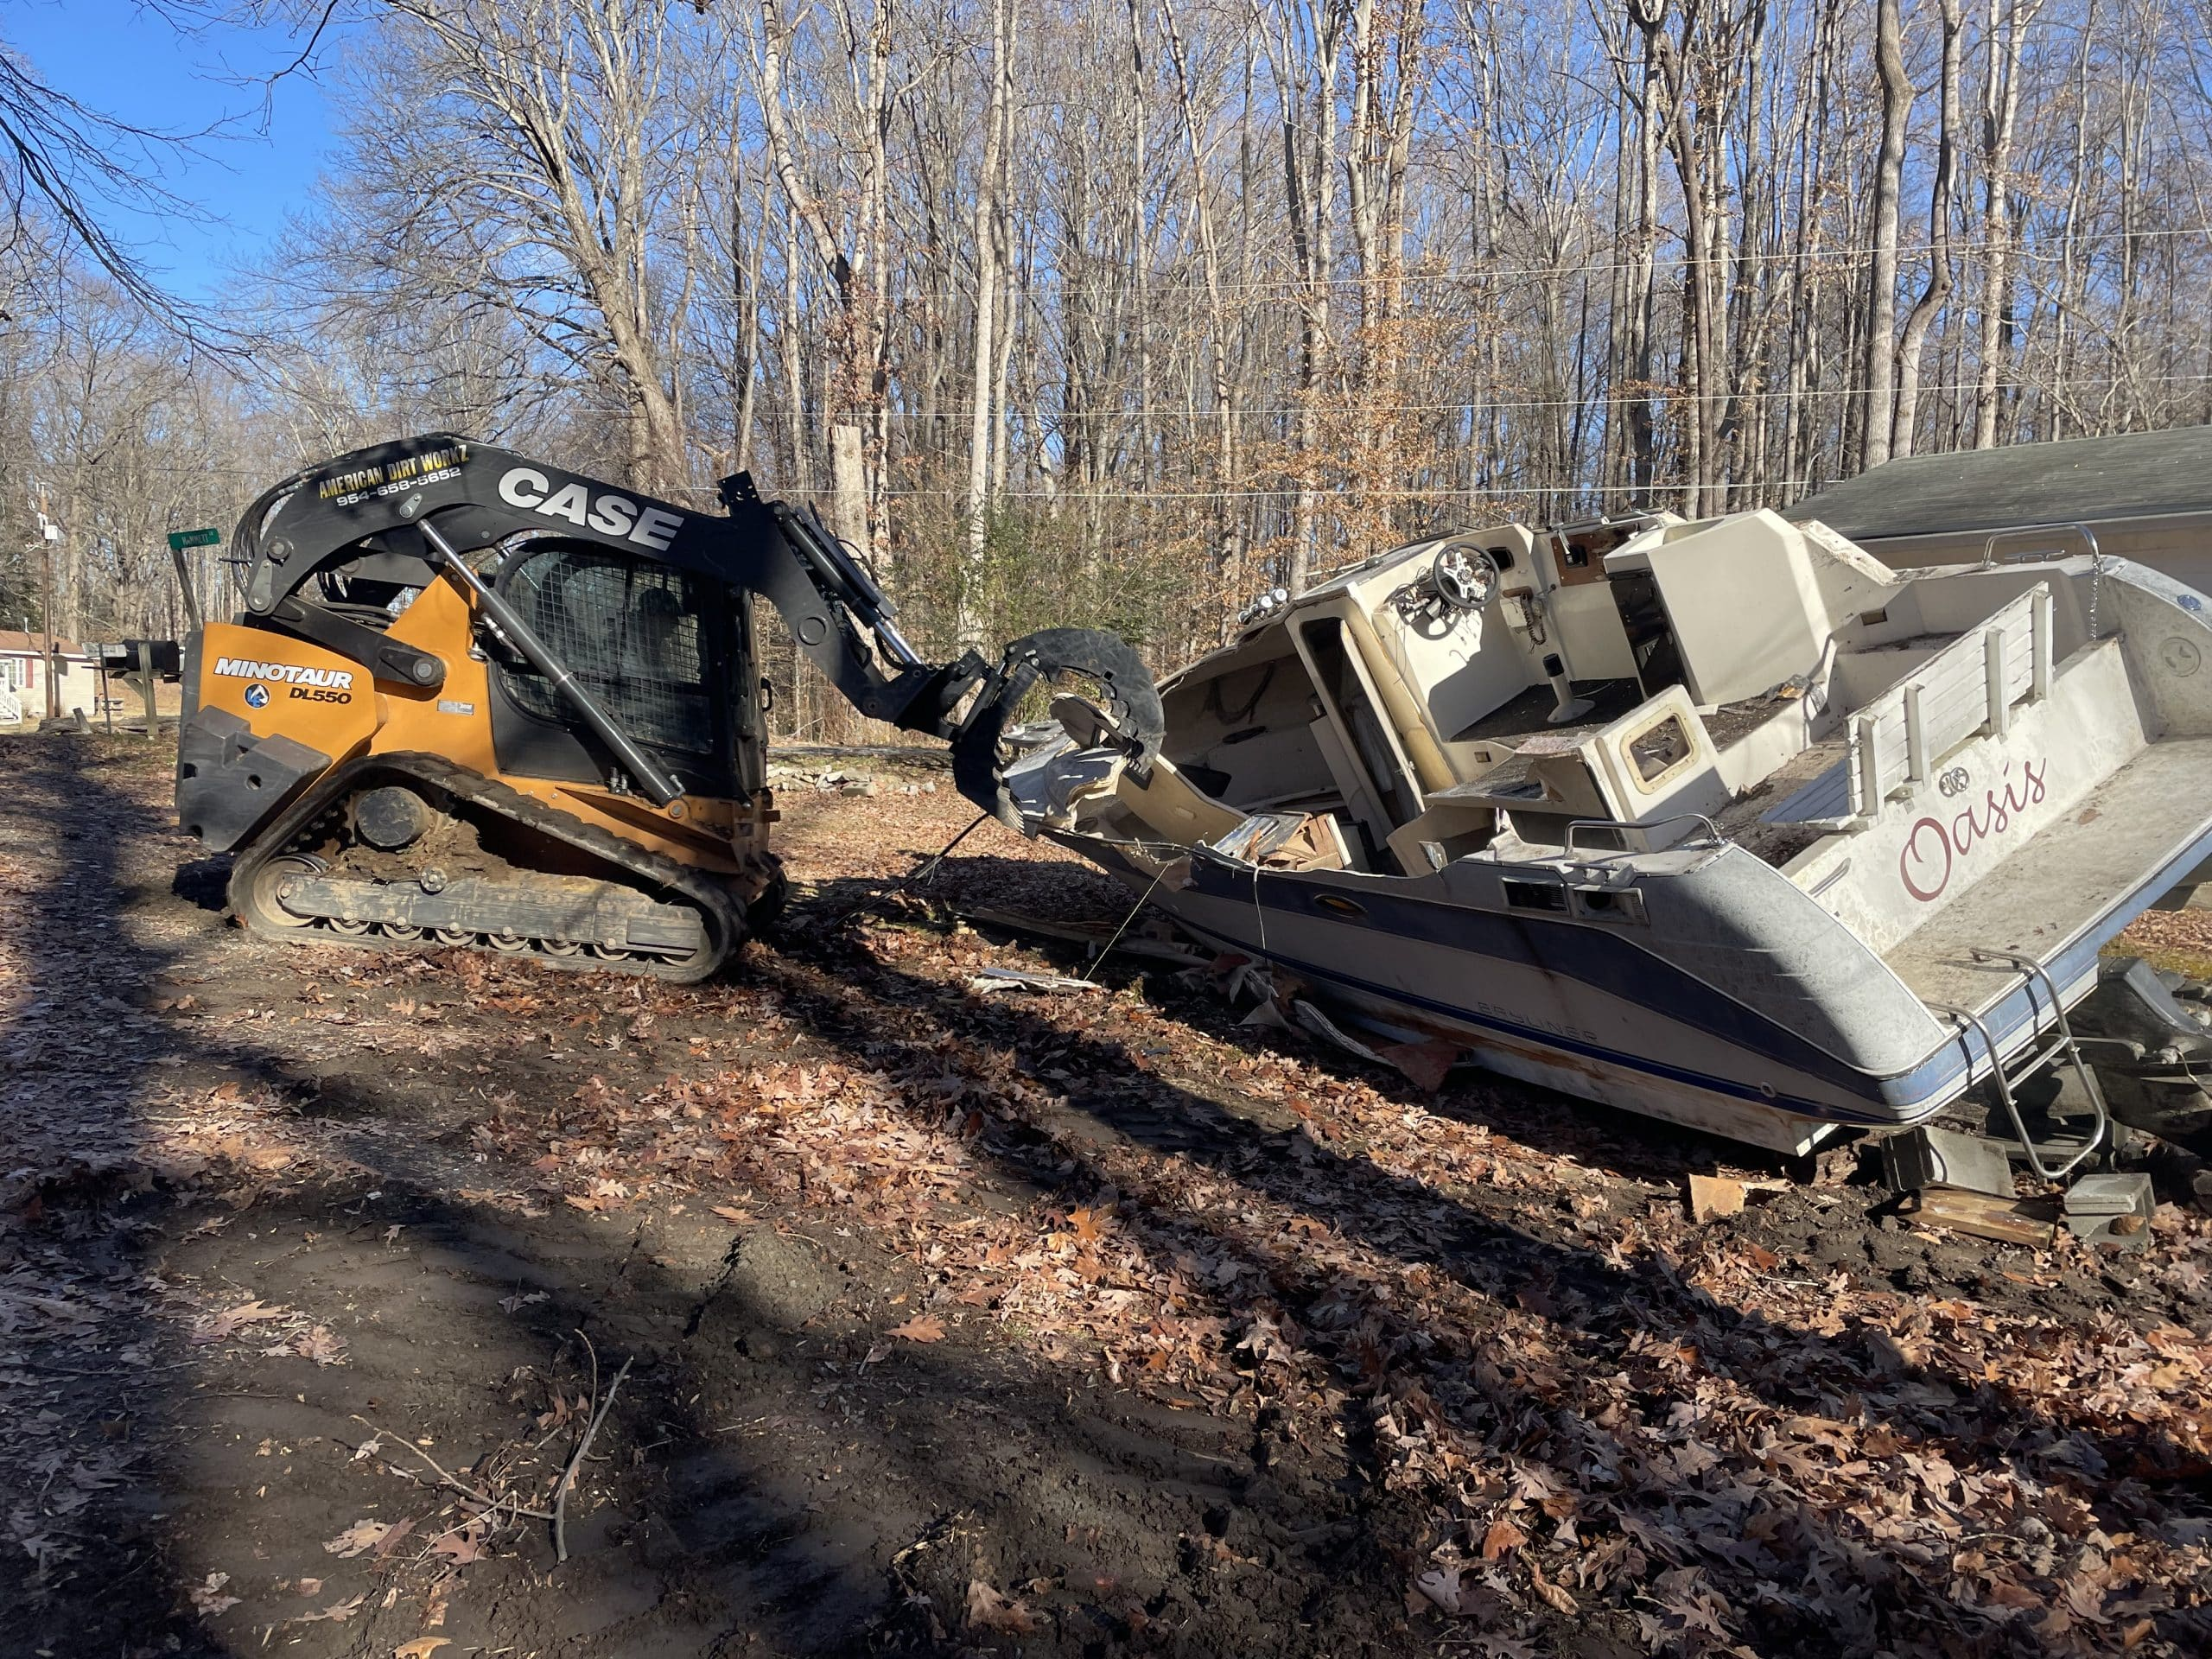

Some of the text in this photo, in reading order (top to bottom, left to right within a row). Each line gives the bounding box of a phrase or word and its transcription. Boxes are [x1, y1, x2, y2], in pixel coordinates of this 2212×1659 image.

[319, 444, 469, 499] AMERICAN DIRT WORKZ
[336, 467, 461, 506] 954-658-5652
[498, 467, 684, 551] CASE
[213, 657, 353, 690] MINOTAUR
[289, 687, 352, 704] DL550
[1900, 758, 2046, 902] Oasis
